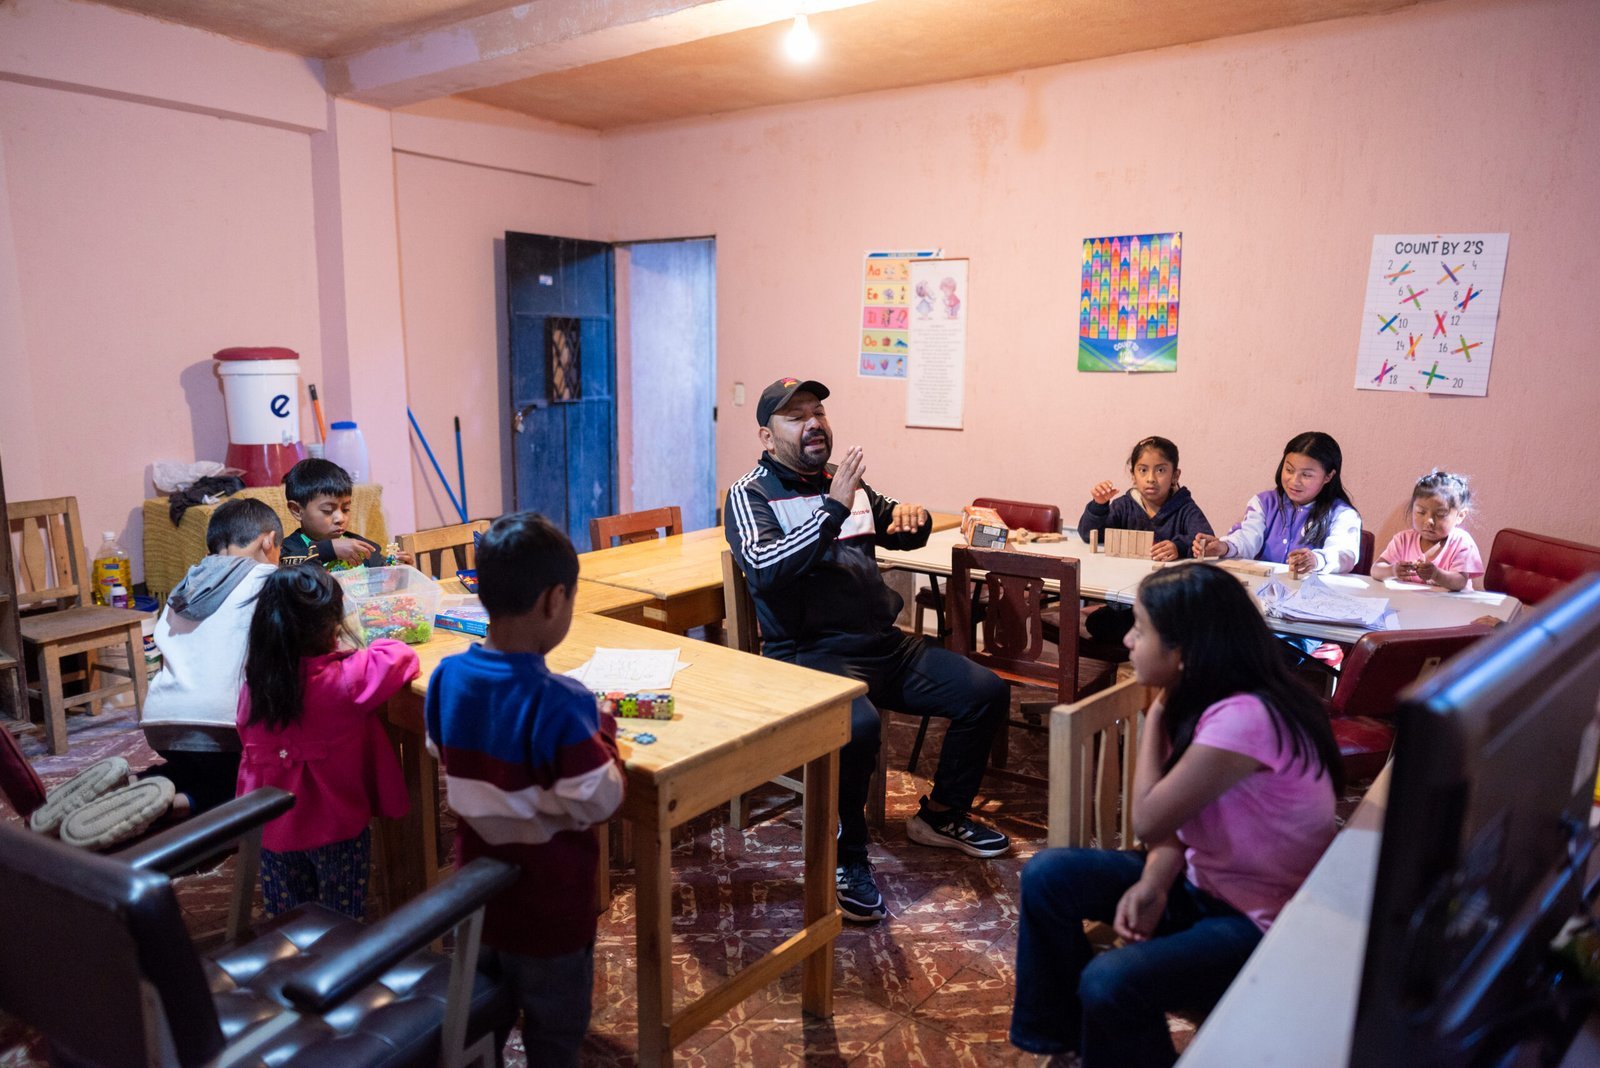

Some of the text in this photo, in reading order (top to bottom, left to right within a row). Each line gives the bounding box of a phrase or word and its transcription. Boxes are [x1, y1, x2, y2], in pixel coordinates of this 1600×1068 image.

[1395, 240, 1484, 255] COUNT BY 2'S
[1388, 260, 1393, 270] 2
[1472, 260, 1477, 270] 4
[1398, 286, 1404, 296] 6
[1453, 291, 1459, 301] 8
[1399, 318, 1408, 328] 10
[1451, 315, 1460, 326] 12
[1396, 341, 1405, 351] 14
[1438, 343, 1448, 353] 16
[1389, 374, 1398, 384] 18
[1452, 378, 1464, 388] 20
[270, 394, 290, 418] e
